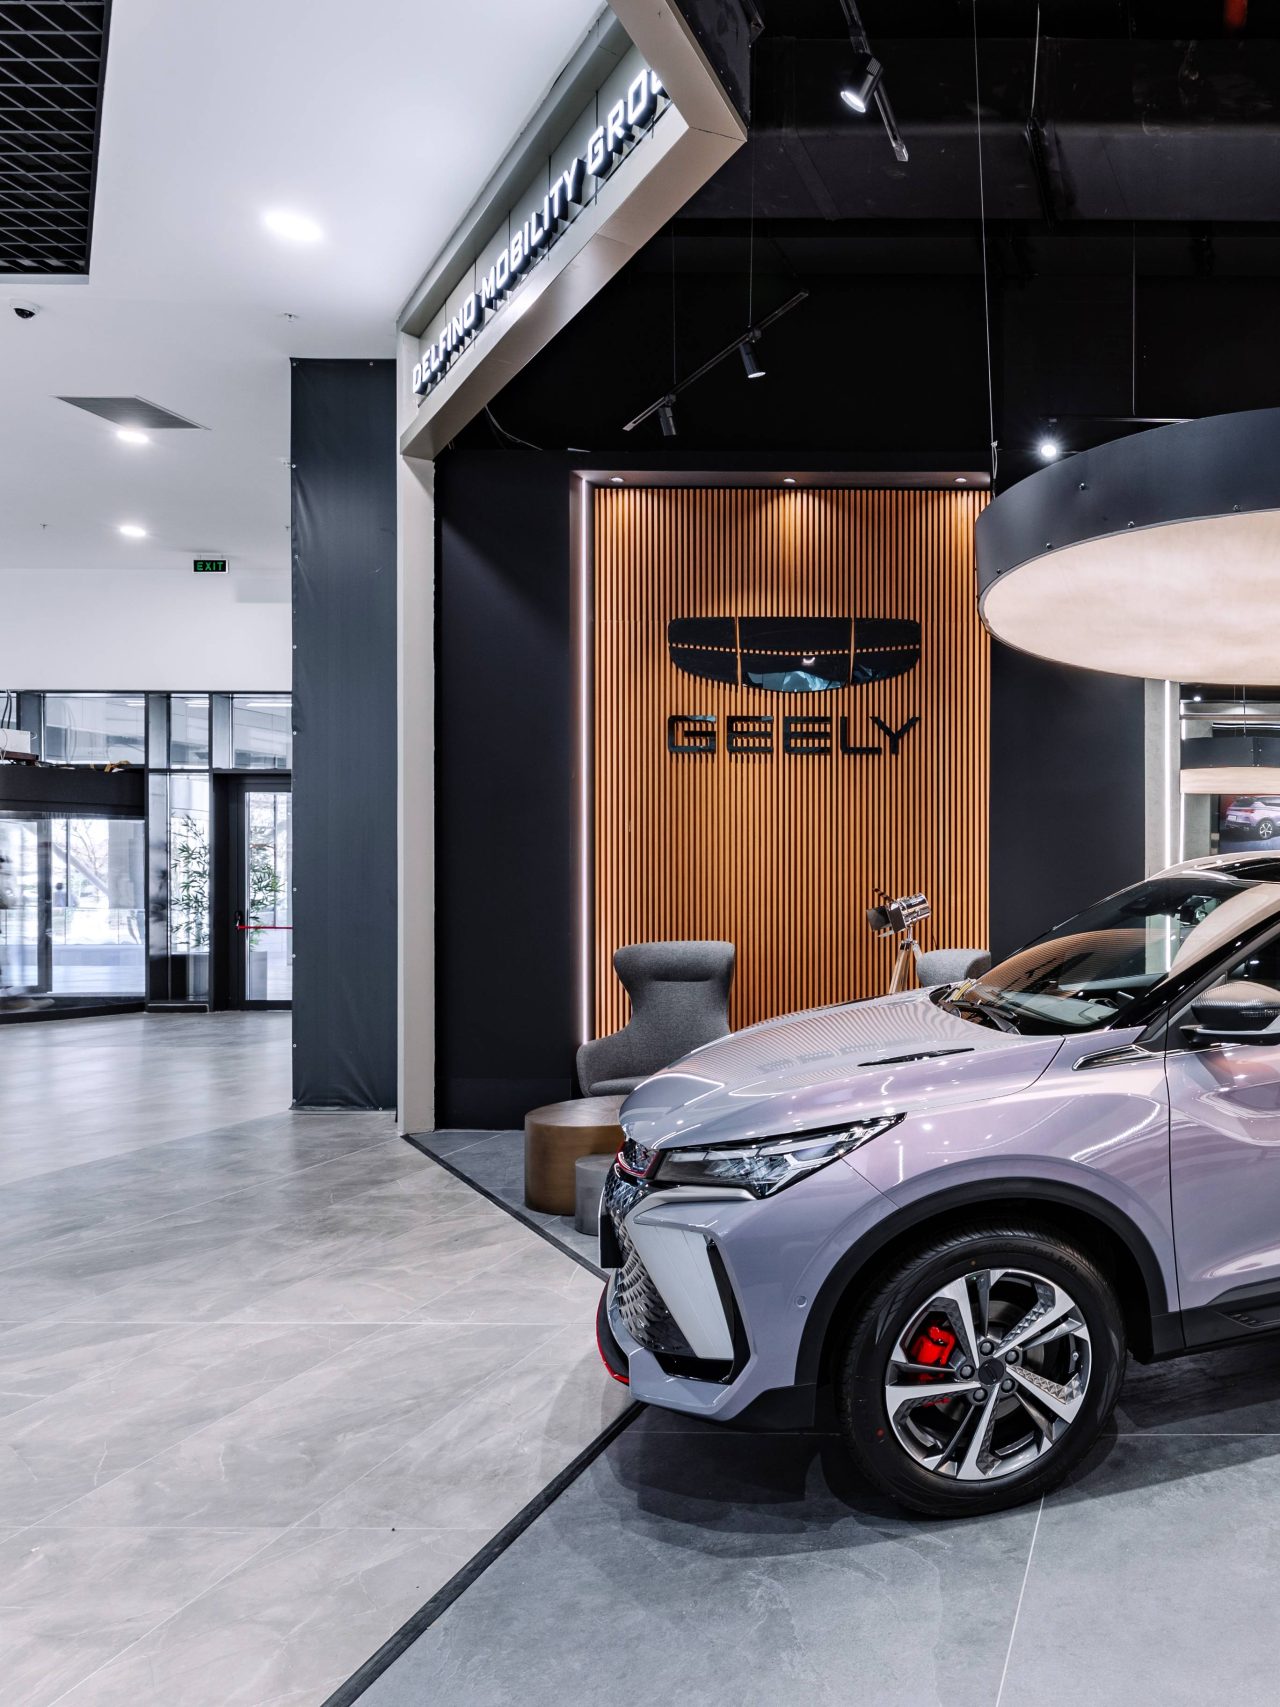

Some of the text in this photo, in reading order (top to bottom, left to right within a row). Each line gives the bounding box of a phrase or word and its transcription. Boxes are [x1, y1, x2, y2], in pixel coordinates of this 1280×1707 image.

[412, 292, 480, 393] DELFINO
[481, 157, 581, 307] MOBILITY
[196, 561, 224, 571] EXIT
[668, 716, 920, 754] GEELY
